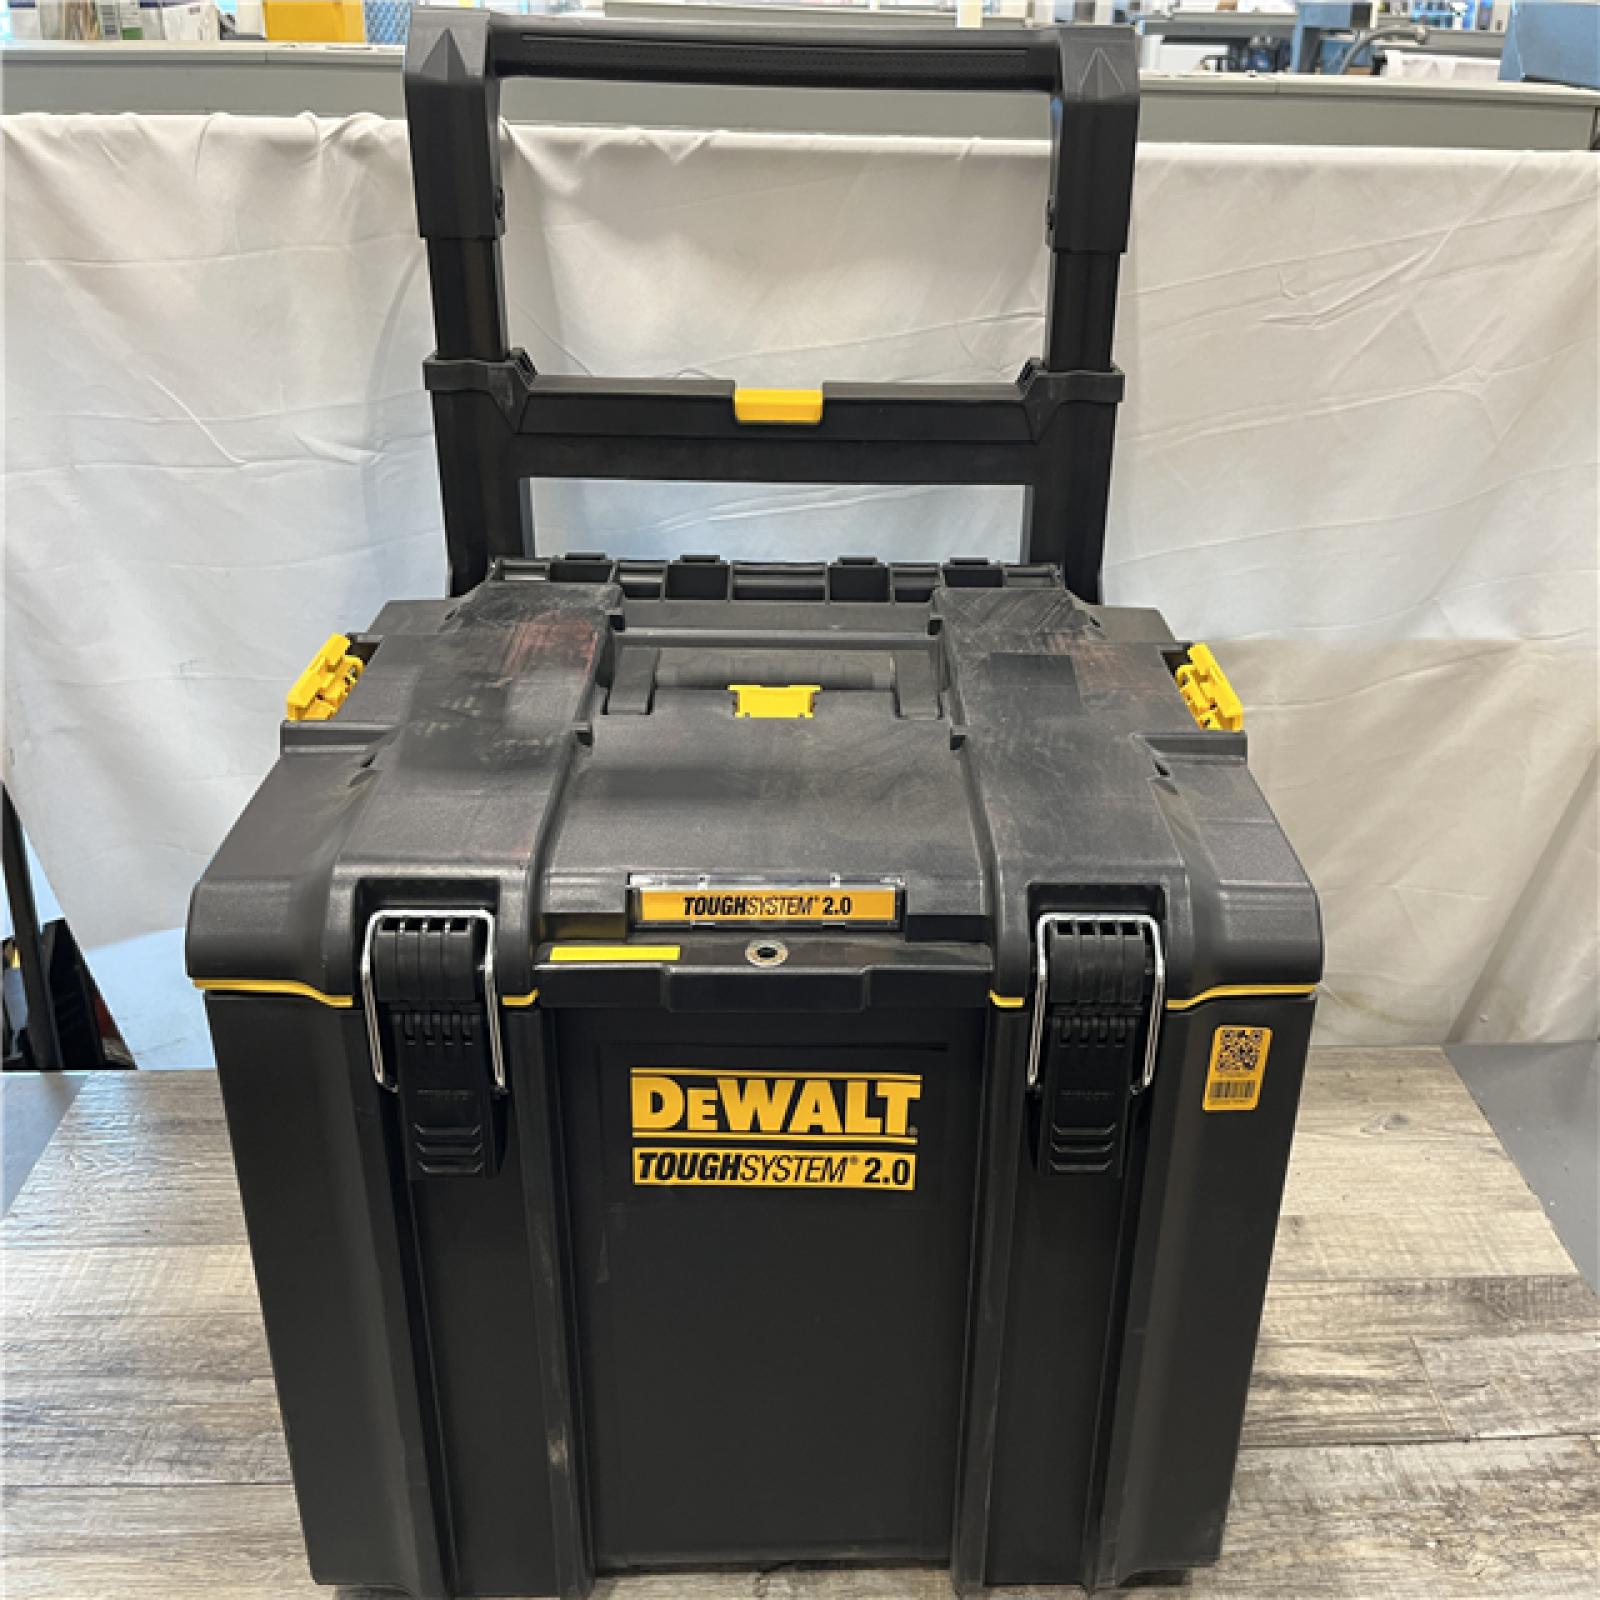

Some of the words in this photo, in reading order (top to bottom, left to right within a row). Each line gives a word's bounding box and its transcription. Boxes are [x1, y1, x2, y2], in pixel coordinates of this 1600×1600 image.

[822, 896, 853, 916] 2.0
[631, 1076, 921, 1136] DEWALT
[863, 1156, 911, 1186] 2.0
